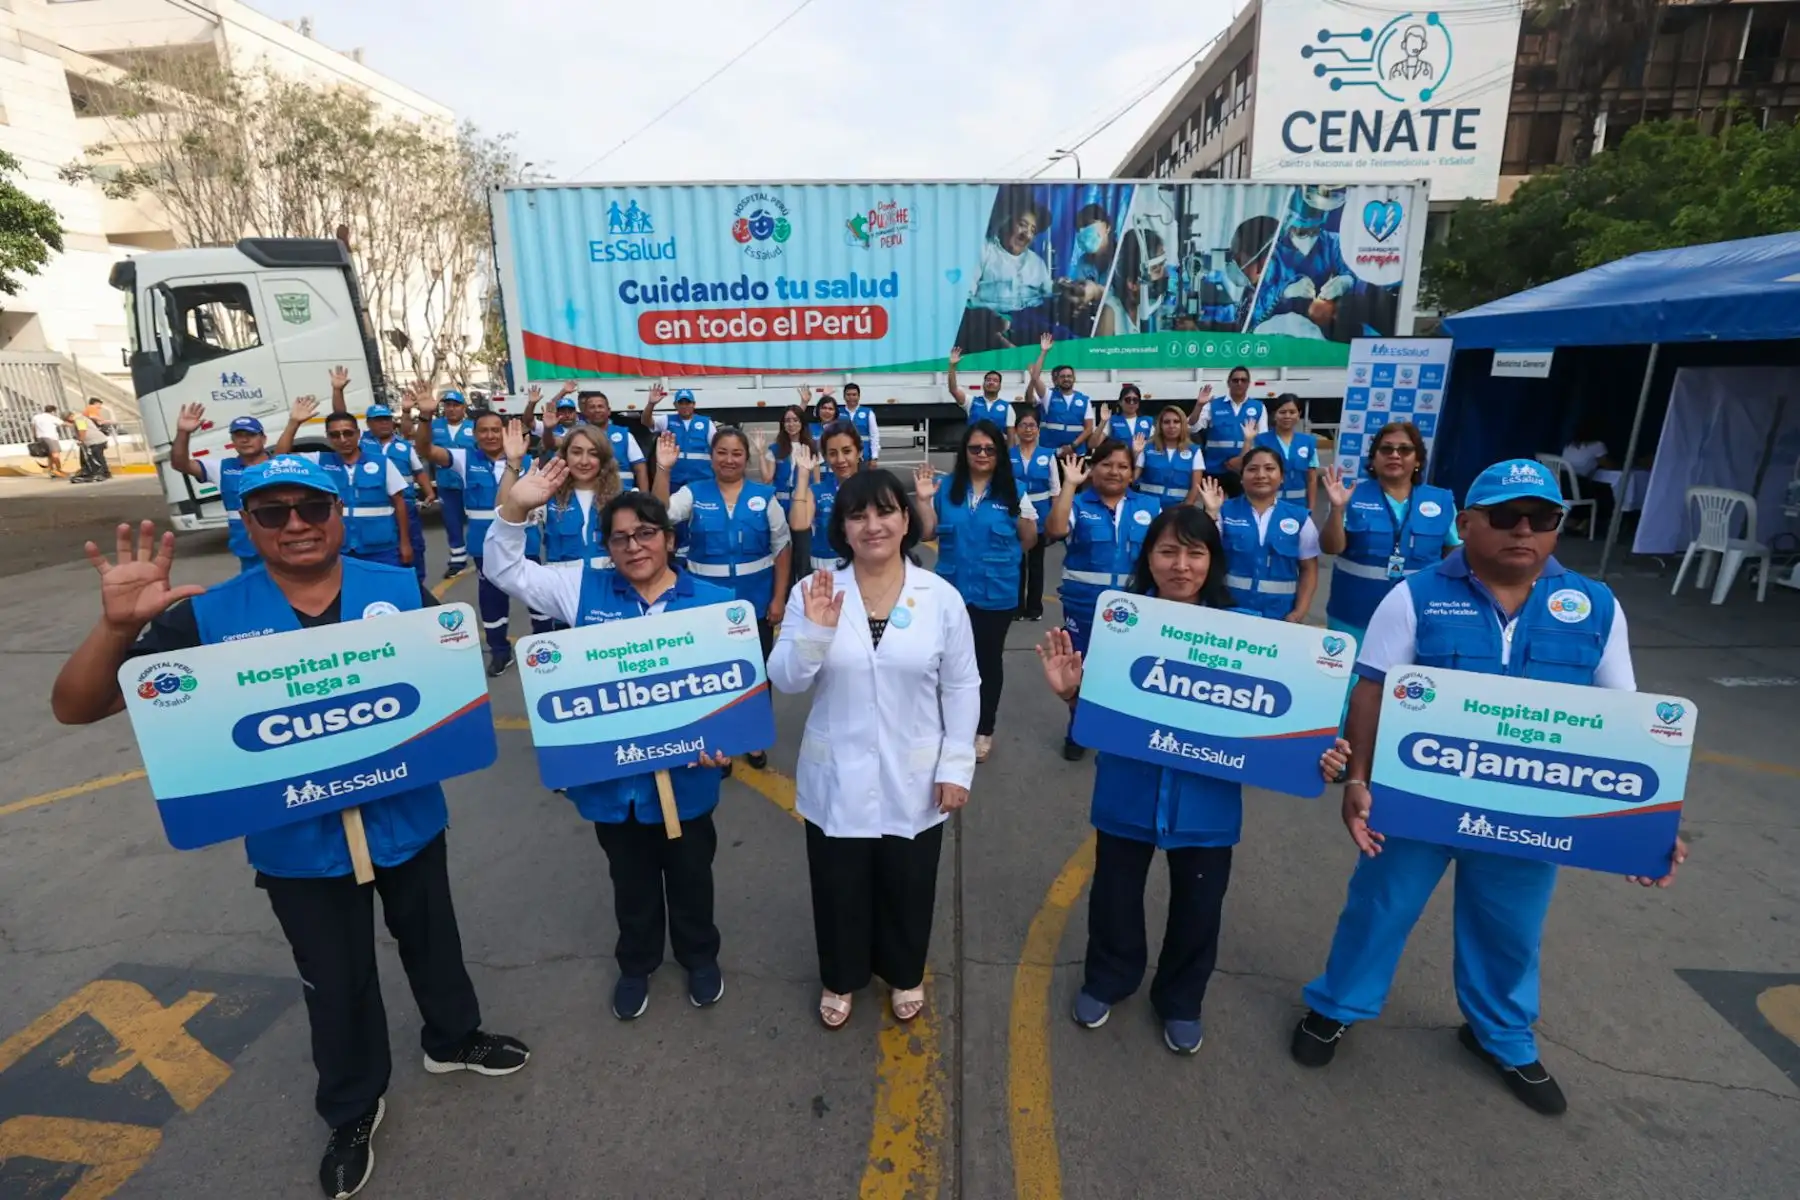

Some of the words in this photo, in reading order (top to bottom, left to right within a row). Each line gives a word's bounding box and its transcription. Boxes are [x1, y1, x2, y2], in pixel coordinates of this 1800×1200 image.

[1281, 108, 1481, 154] CENATE
[1279, 158, 1311, 168] Centro
[1313, 158, 1353, 168] Nacional
[1355, 158, 1367, 167] de
[1370, 157, 1429, 168] Telemedicina
[1439, 156, 1476, 166] EsSalud
[734, 193, 769, 217] HOSPITAL
[590, 236, 676, 263] EsSalud
[744, 244, 783, 261] EsSalud
[618, 274, 769, 305] Cuidando
[775, 276, 808, 300] tu
[815, 271, 899, 299] salud
[655, 317, 691, 339] en
[697, 311, 767, 338] todo
[773, 310, 798, 336] el
[805, 306, 872, 336] Perú
[1390, 347, 1430, 357] EsSalud
[211, 387, 263, 401] EsSalud
[263, 467, 309, 479] EsSalud
[1502, 475, 1545, 486] EsSalud
[1429, 600, 1460, 608] Gerencia
[586, 639, 654, 662] Hospital
[656, 631, 695, 650] Perú
[1160, 623, 1233, 649] Hospital
[1236, 639, 1279, 659] Perú
[138, 661, 171, 681] HOSPITAL
[236, 653, 340, 686] Hospital
[344, 641, 396, 666] Perú
[618, 658, 657, 674] llega
[659, 656, 669, 667] a
[1187, 647, 1228, 669] llega
[1230, 660, 1242, 670] a
[287, 677, 344, 698] llega
[346, 673, 361, 686] a
[551, 695, 594, 720] La
[598, 663, 743, 712] Libertad
[1142, 656, 1276, 715] Áncash
[153, 693, 191, 708] EsSalud
[257, 696, 401, 745] Cusco
[1463, 699, 1550, 723] Hospital
[1553, 710, 1603, 730] Perú
[1496, 721, 1546, 744] llega
[1548, 732, 1562, 744] a
[647, 736, 705, 760] EsSalud
[1181, 743, 1245, 770] EsSalud
[329, 762, 408, 797] EsSalud
[1411, 738, 1643, 797] Cajamarca
[1496, 825, 1573, 852] EsSalud
